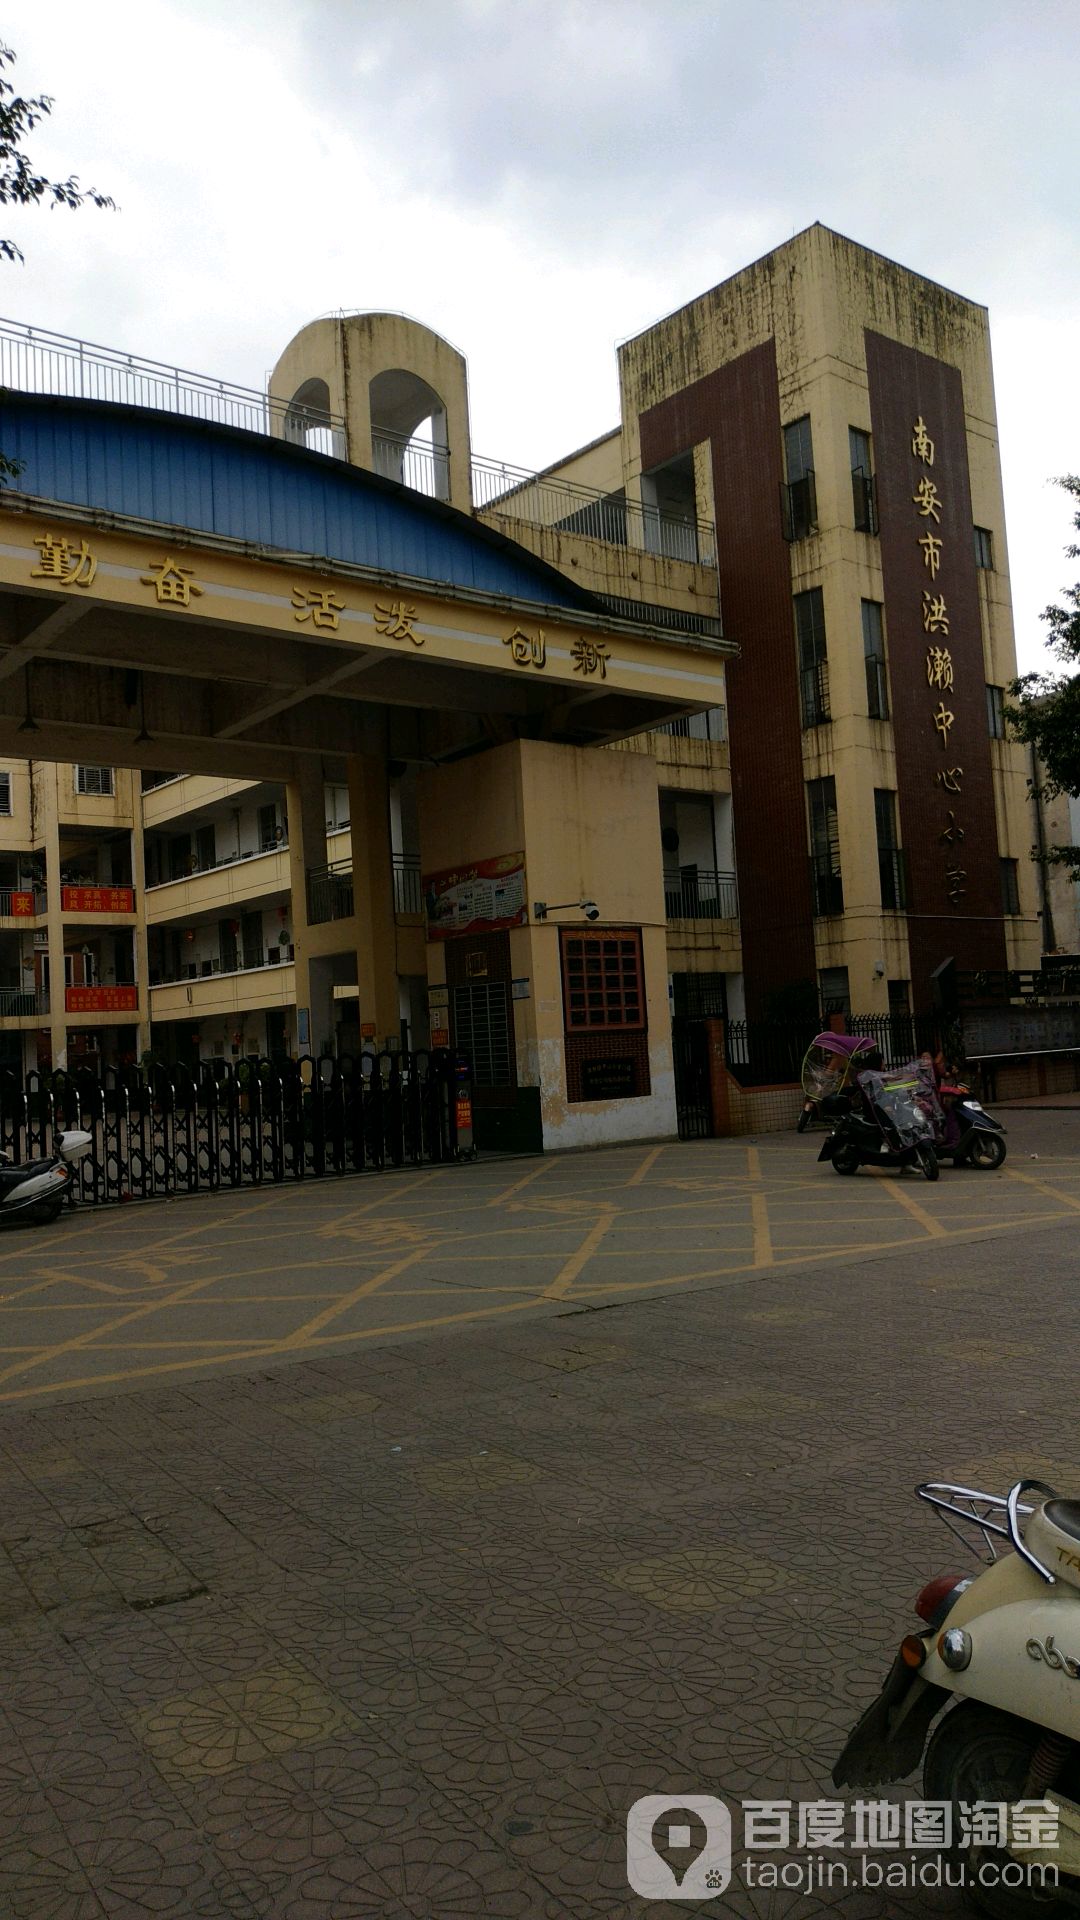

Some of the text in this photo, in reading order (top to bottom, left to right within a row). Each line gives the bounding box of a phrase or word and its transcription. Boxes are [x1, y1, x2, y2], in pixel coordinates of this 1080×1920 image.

[30, 533, 612, 680] 勤奋 活泼 创新
[16, 896, 31, 913] 来
